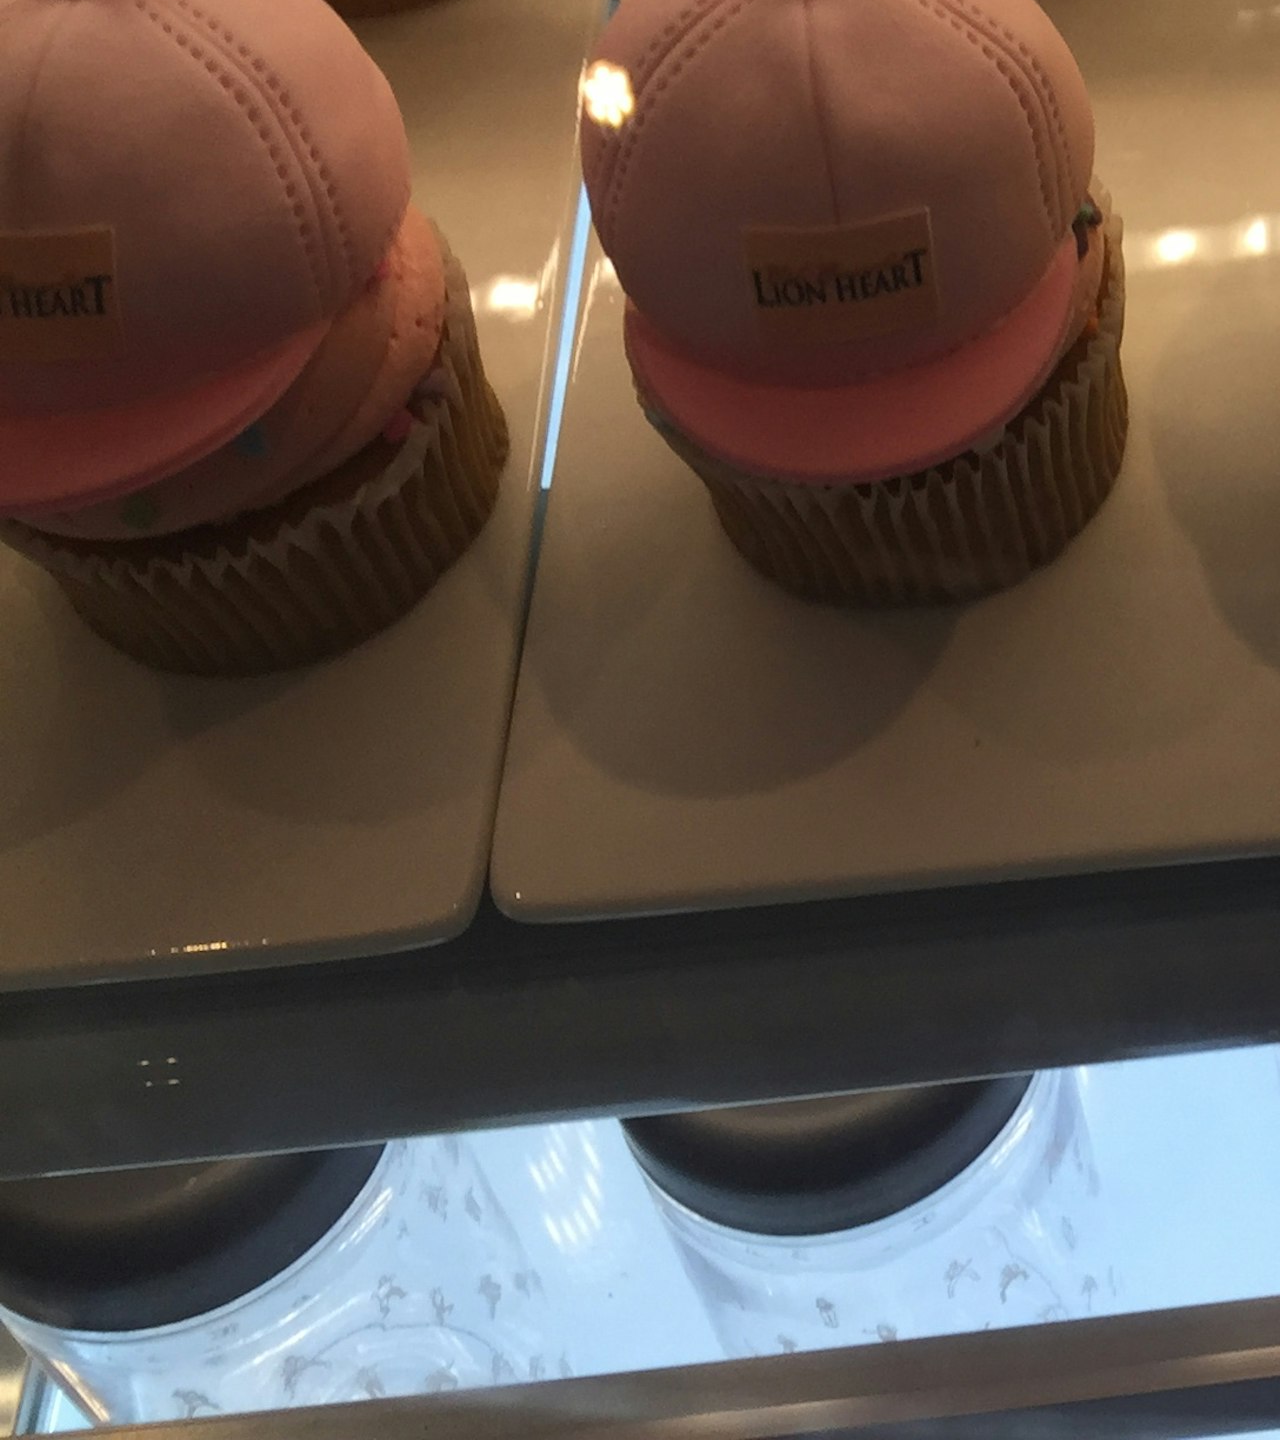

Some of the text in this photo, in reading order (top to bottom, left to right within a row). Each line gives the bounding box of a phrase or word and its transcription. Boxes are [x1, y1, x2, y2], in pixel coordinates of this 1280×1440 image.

[8, 273, 113, 318] HEART
[751, 247, 929, 309] LION HEART
